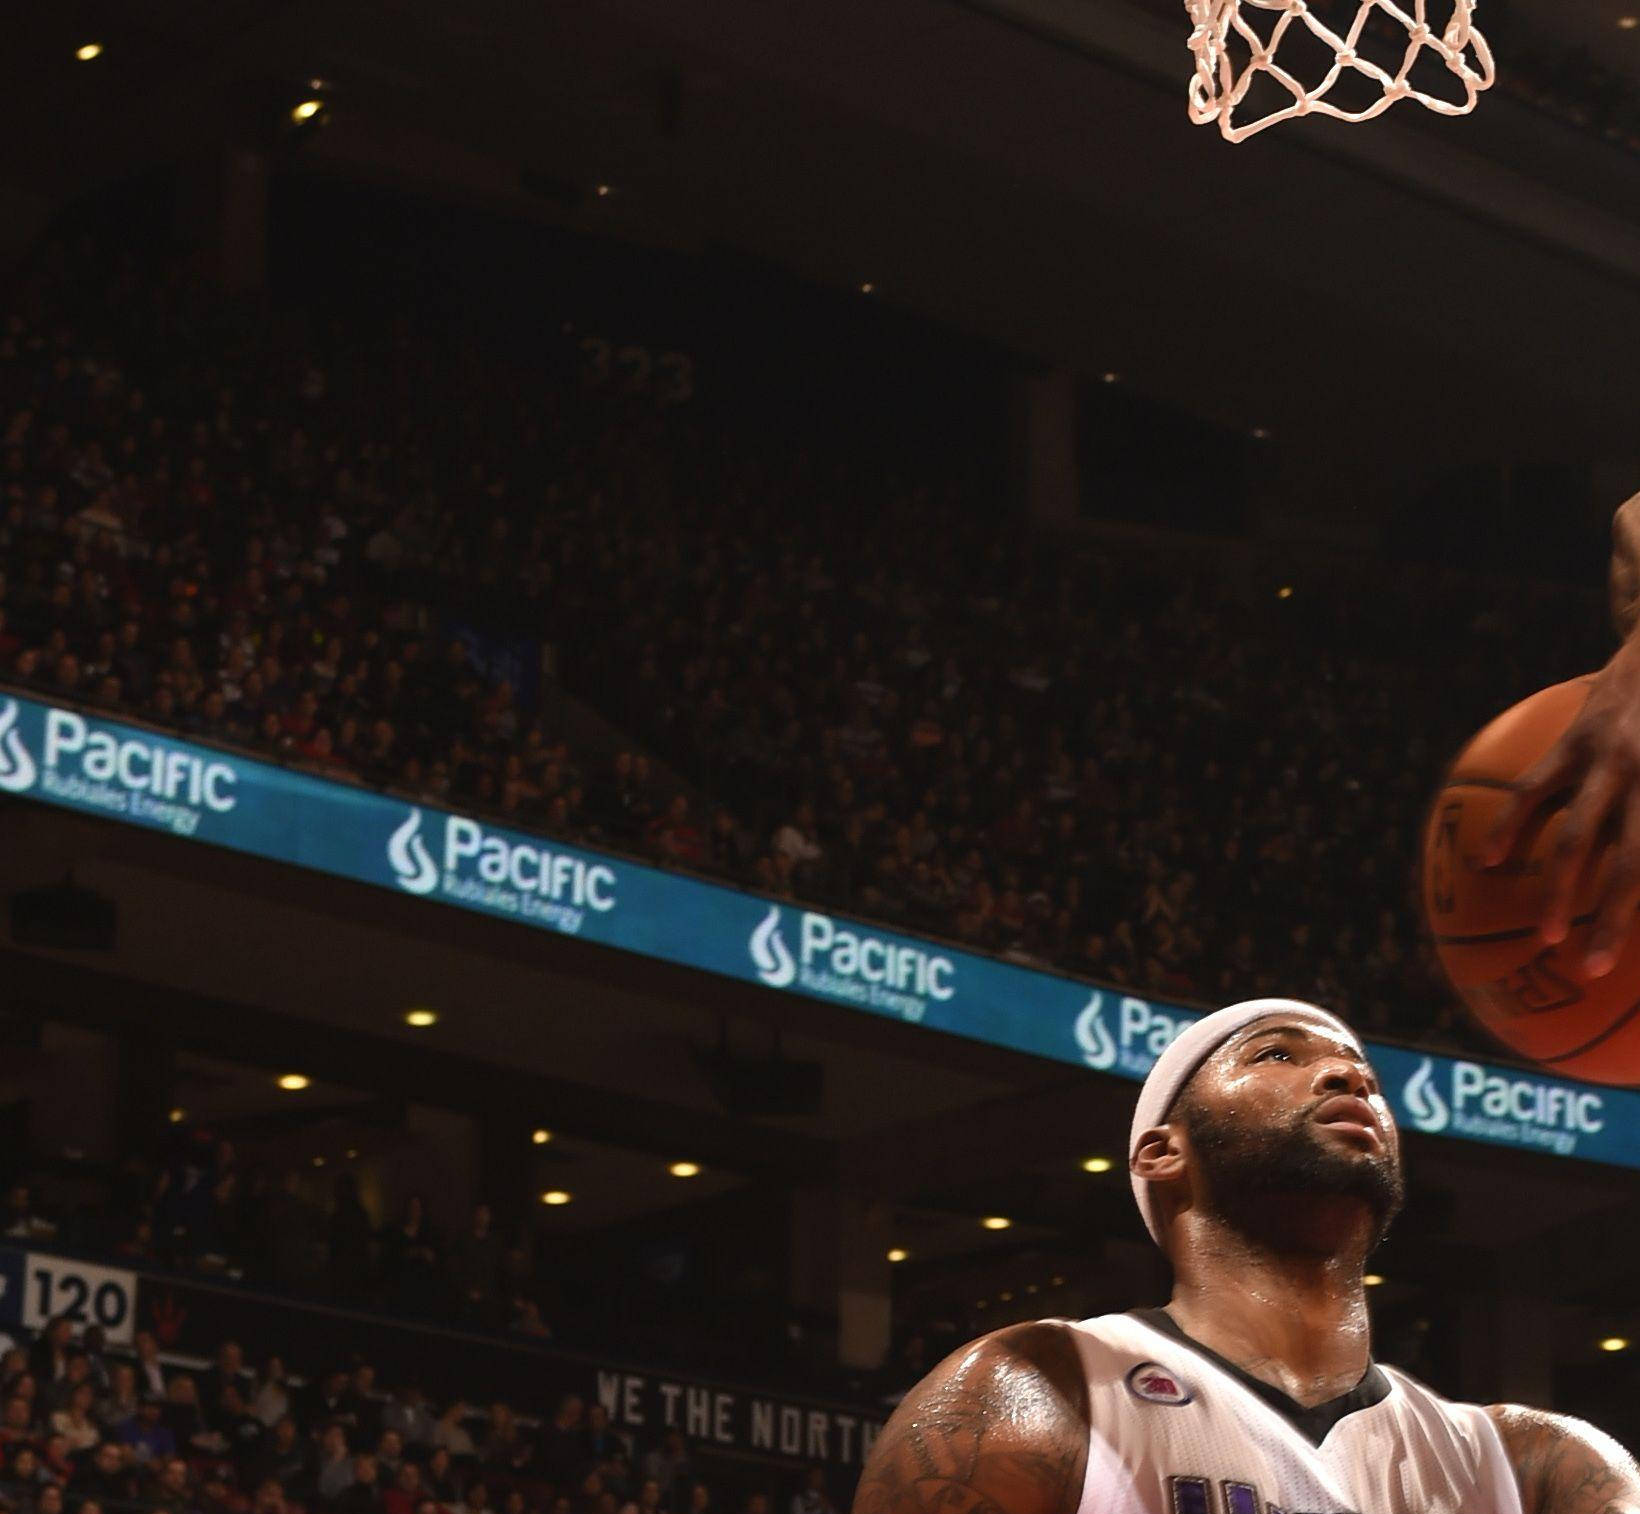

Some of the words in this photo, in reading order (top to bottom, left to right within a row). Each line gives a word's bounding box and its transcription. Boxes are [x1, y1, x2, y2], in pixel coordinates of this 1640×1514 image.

[36, 1270, 127, 1328] 120
[597, 1370, 646, 1426] WE
[659, 1382, 735, 1444] THE
